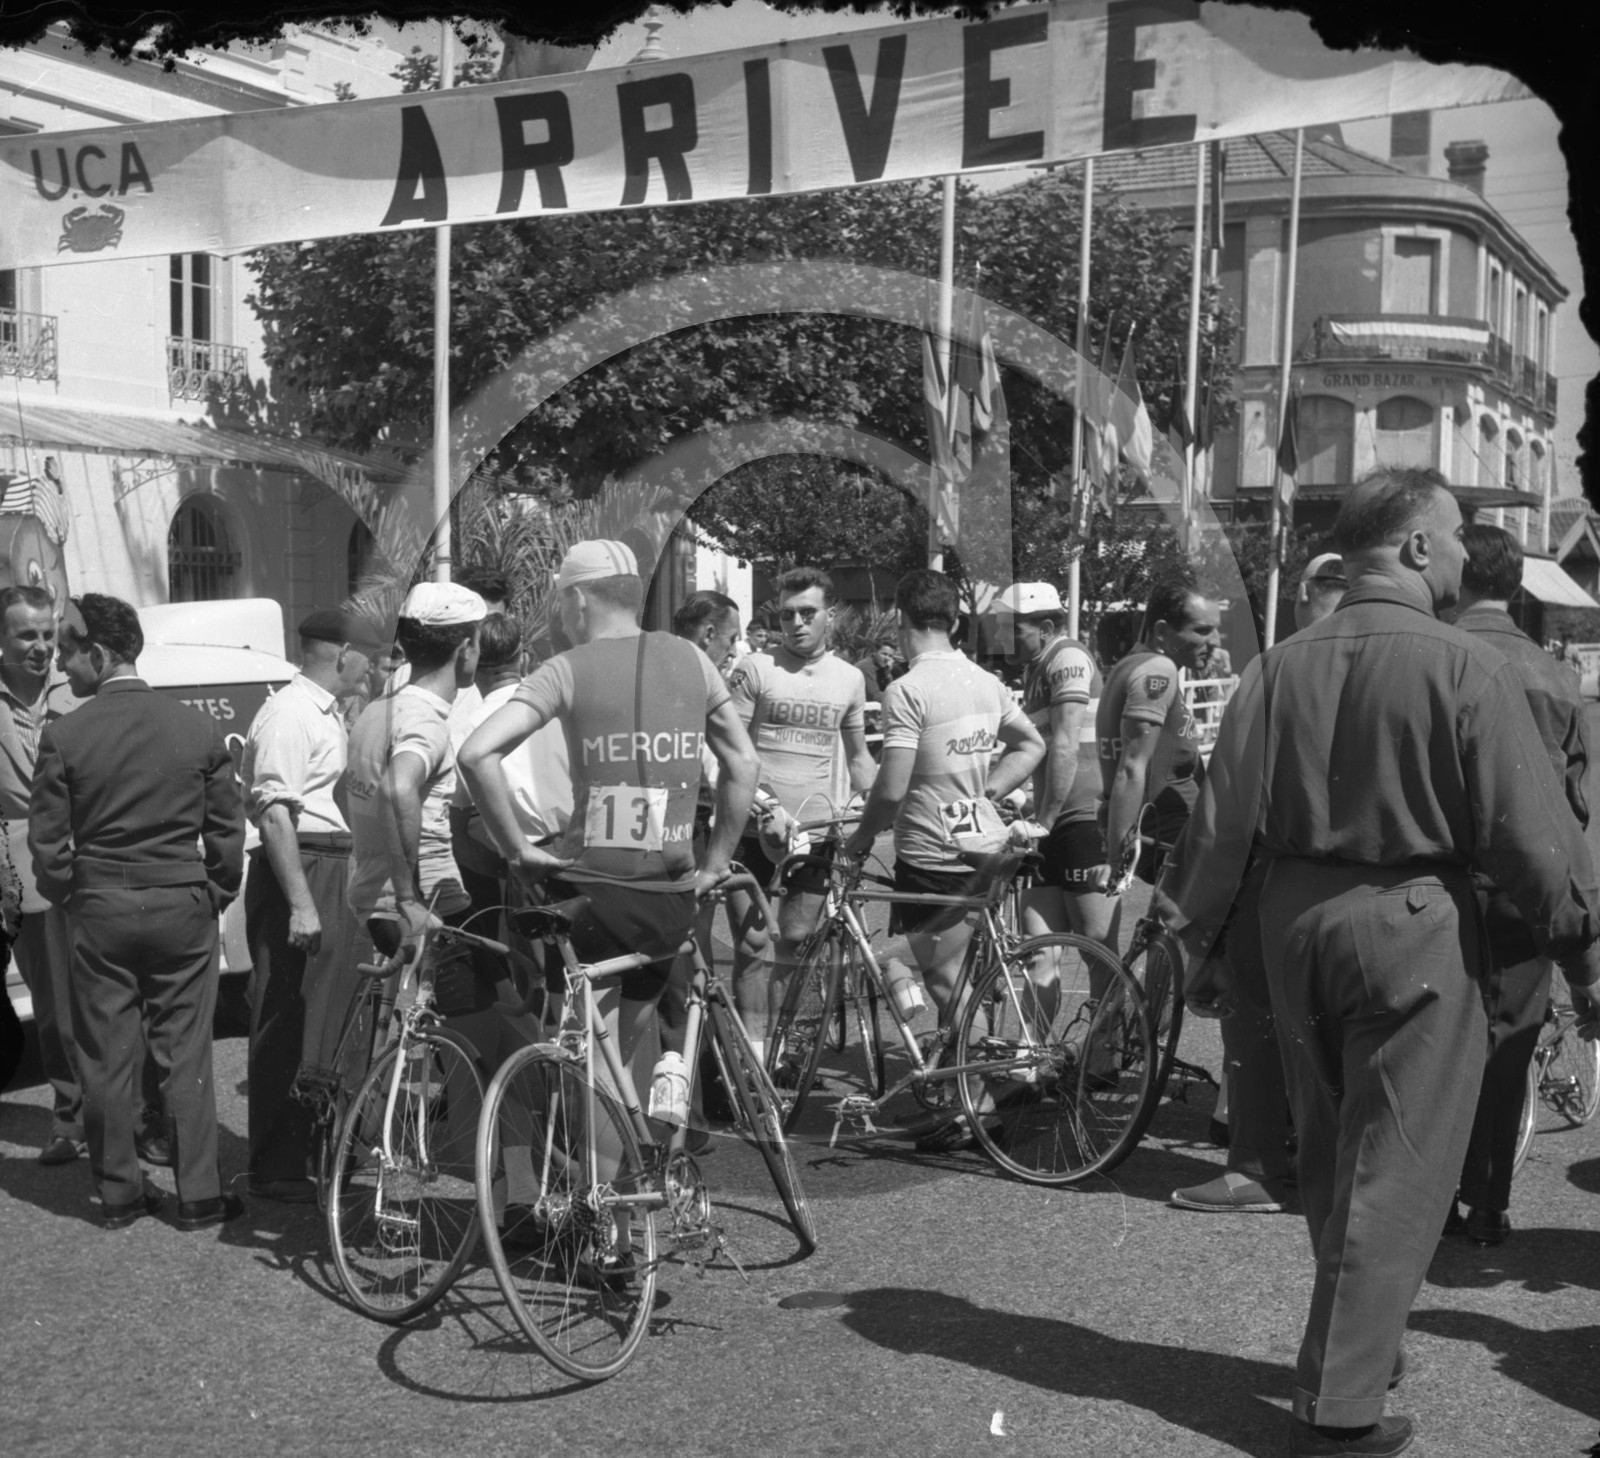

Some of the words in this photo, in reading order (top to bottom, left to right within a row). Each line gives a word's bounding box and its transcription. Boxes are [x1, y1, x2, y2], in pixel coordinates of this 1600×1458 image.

[380, 0, 1199, 226] ARRIVEE
[1322, 373, 1370, 388] GRAND
[1373, 373, 1416, 388] BAZAR
[1149, 677, 1168, 691] BP
[602, 793, 650, 842] 13
[943, 800, 983, 835] 21
